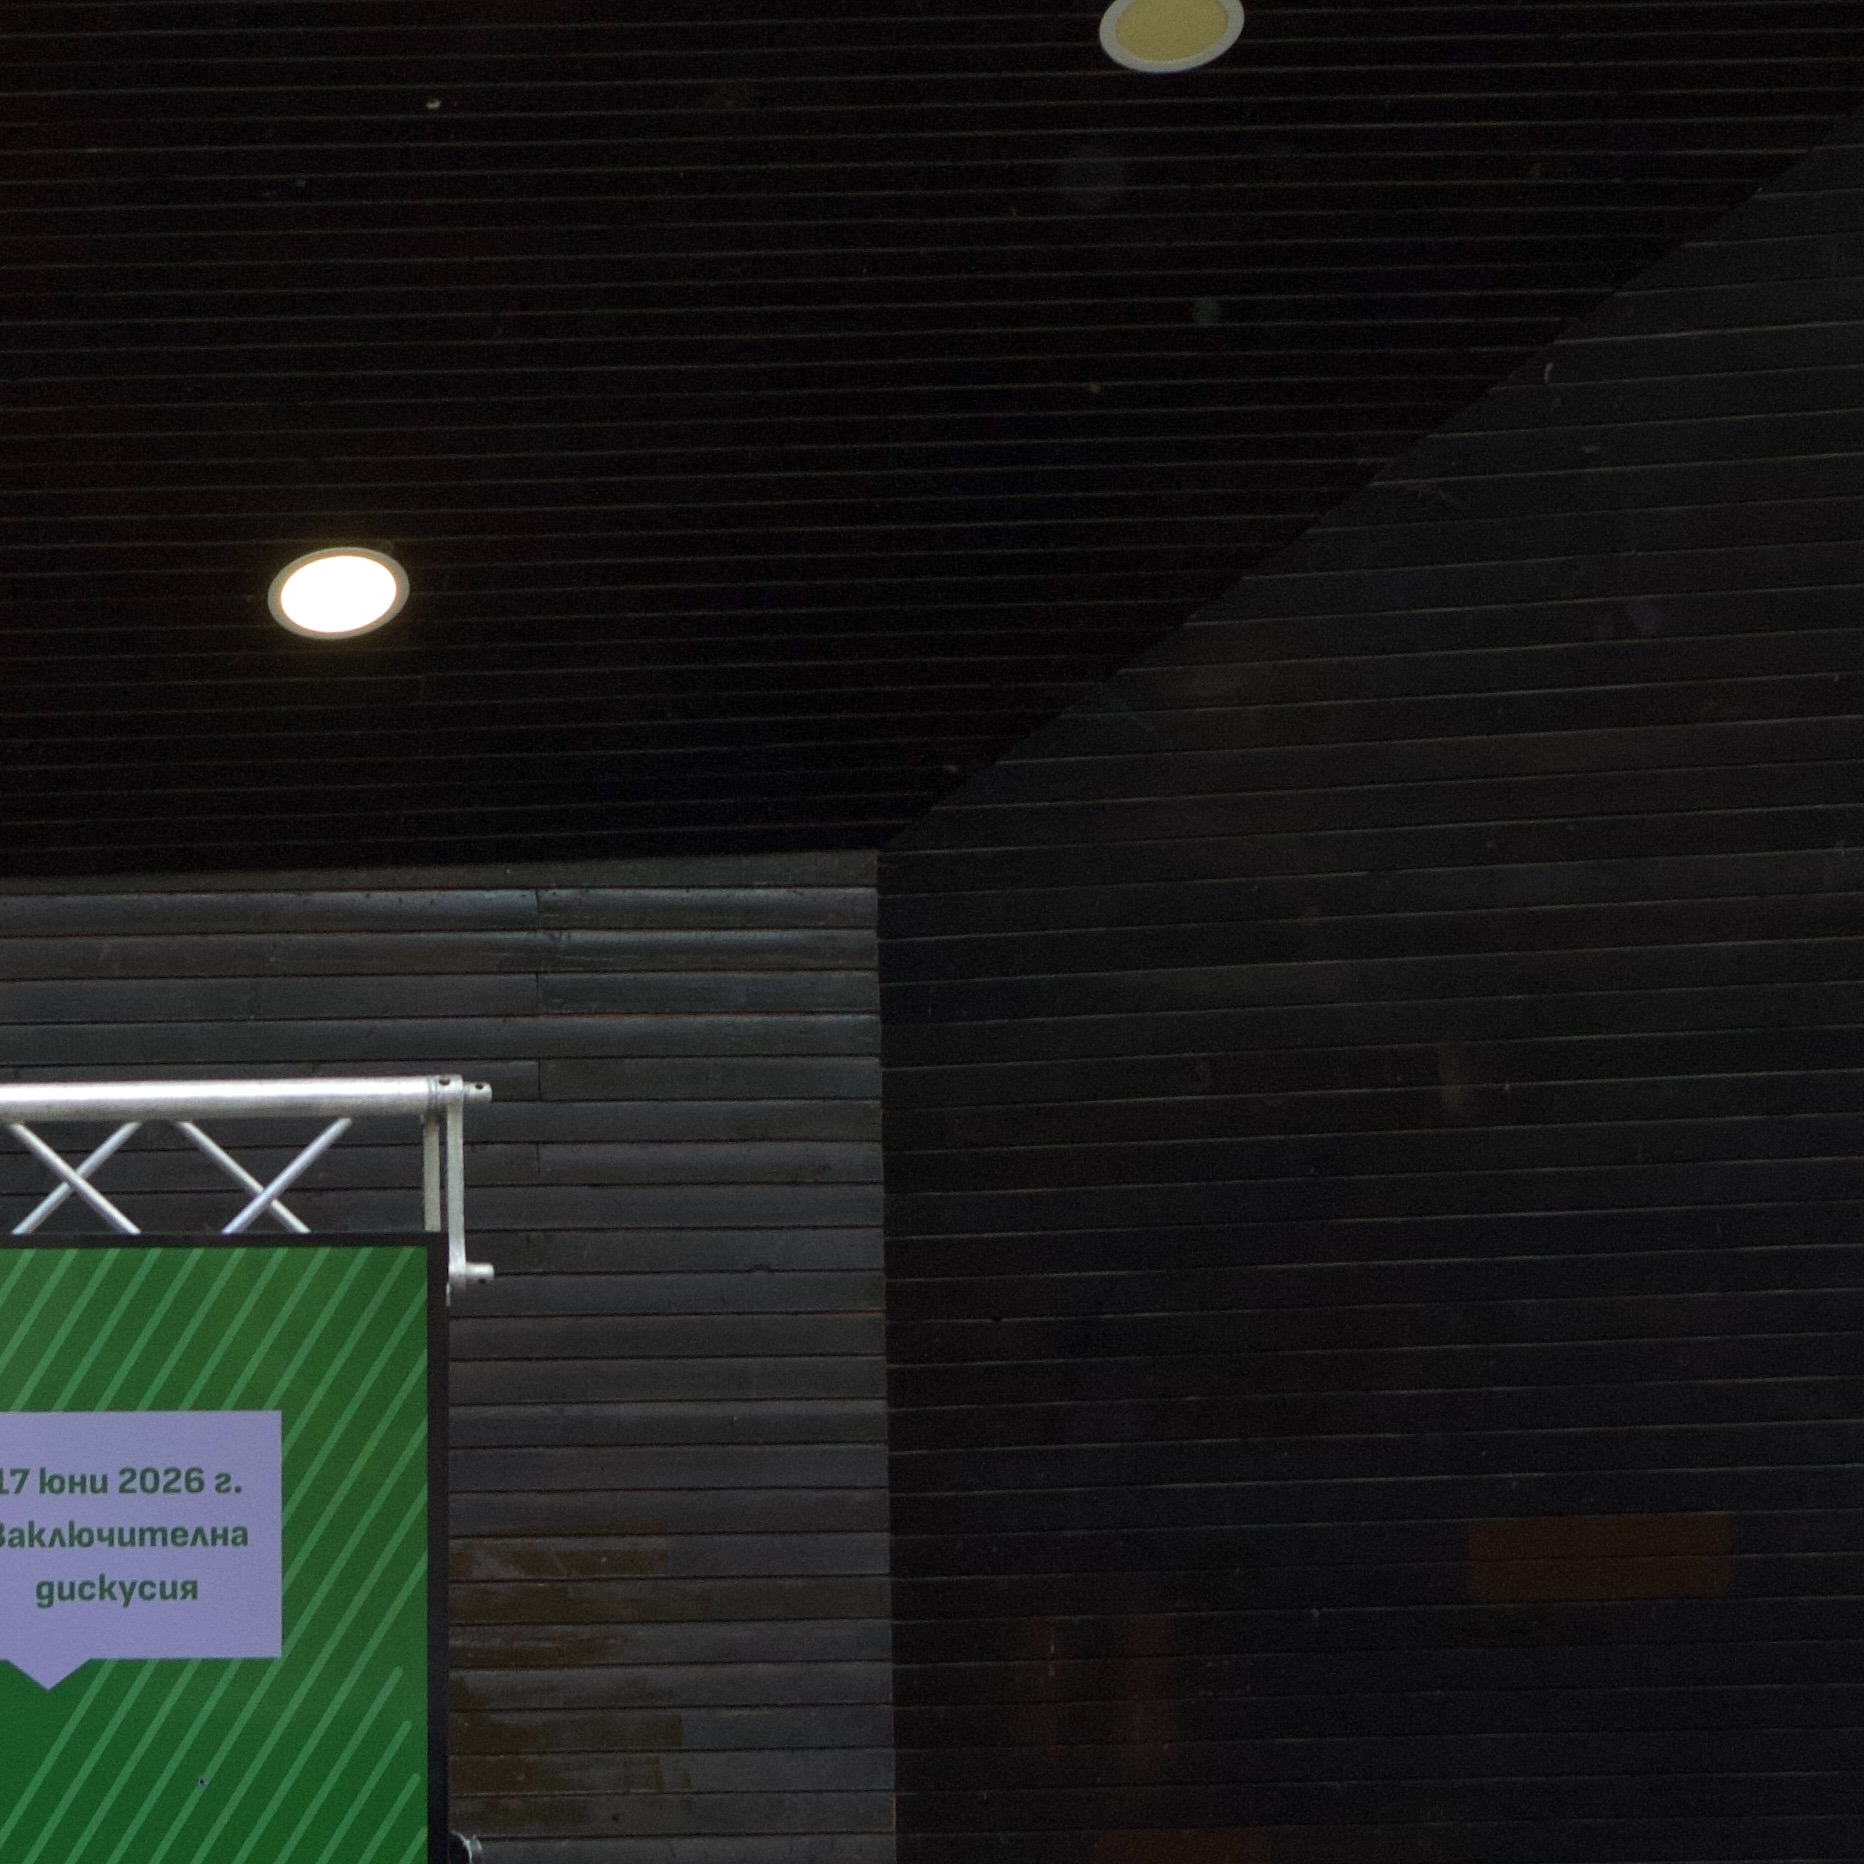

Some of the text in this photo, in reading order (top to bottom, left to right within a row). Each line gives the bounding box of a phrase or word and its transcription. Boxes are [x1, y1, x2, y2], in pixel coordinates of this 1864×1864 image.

[40, 1468, 108, 1495] юни
[119, 1467, 204, 1494] 2026
[215, 1473, 241, 1494] г.
[36, 1574, 198, 1609] дискусия
